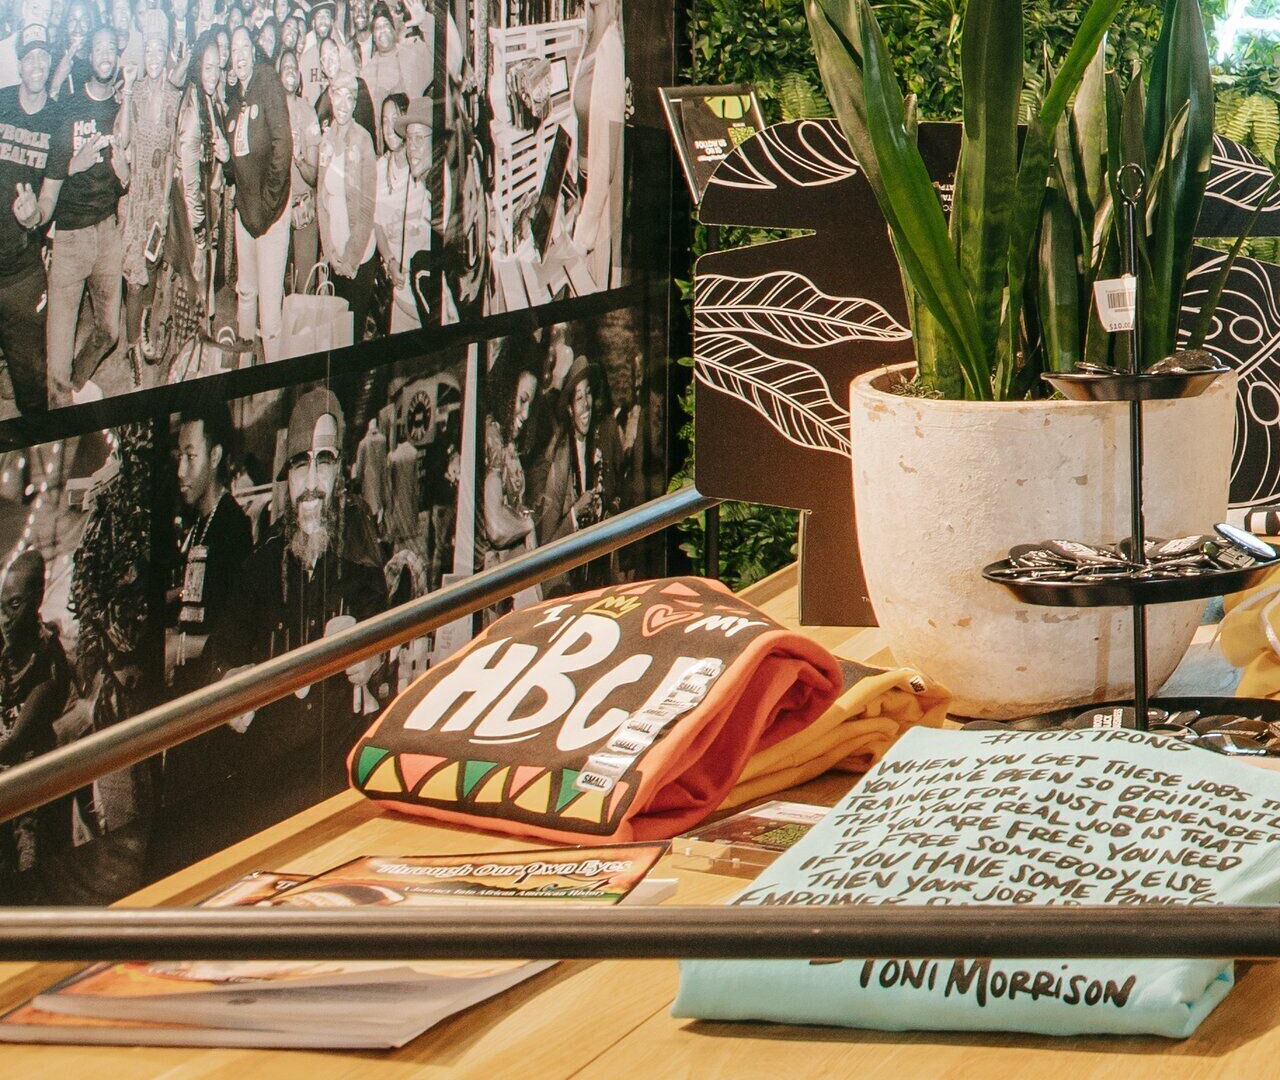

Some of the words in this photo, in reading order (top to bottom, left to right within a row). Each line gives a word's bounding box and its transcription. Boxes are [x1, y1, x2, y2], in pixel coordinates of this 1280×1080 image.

[611, 739, 639, 752] SMALL
[581, 773, 608, 788] SMALL
[862, 777, 911, 794] YOU
[913, 770, 986, 787] HAVE
[992, 768, 1074, 784] BEEN
[1076, 776, 1114, 791] SO
[877, 756, 968, 776] WHEN
[976, 753, 1027, 769] YOU
[1032, 752, 1099, 768] GET
[1103, 760, 1183, 786] THESE
[1187, 779, 1253, 802] JOBS
[845, 787, 961, 812] TRAINED
[964, 785, 1028, 801] FOR,
[1035, 789, 1107, 816] JUST
[834, 806, 911, 826] THAT
[918, 800, 987, 815] YOUR
[993, 801, 1070, 825] REAL
[1076, 819, 1134, 837] JOB
[1141, 825, 1173, 840] IS
[1181, 828, 1259, 853] THAT
[842, 824, 878, 838] IF
[887, 816, 935, 833] YOU
[935, 815, 1002, 832] ARE
[1107, 841, 1159, 862] YOU
[1158, 847, 1244, 871] NEED
[378, 861, 472, 878] Through
[474, 863, 517, 878] Our
[514, 860, 572, 884] Own
[574, 859, 633, 877] Eyes
[799, 856, 848, 871] IF
[850, 848, 912, 870] YOU
[912, 851, 1009, 878] HAVE
[1009, 864, 1098, 899] SOME
[833, 840, 870, 855] TO
[878, 832, 960, 849] FREE
[966, 835, 1142, 890] SOMEBODY
[479, 888, 514, 897] African
[515, 888, 566, 897] American
[567, 889, 605, 898] History
[808, 869, 899, 890] THEN
[897, 874, 978, 897] YOUR
[973, 880, 1038, 905] JOB
